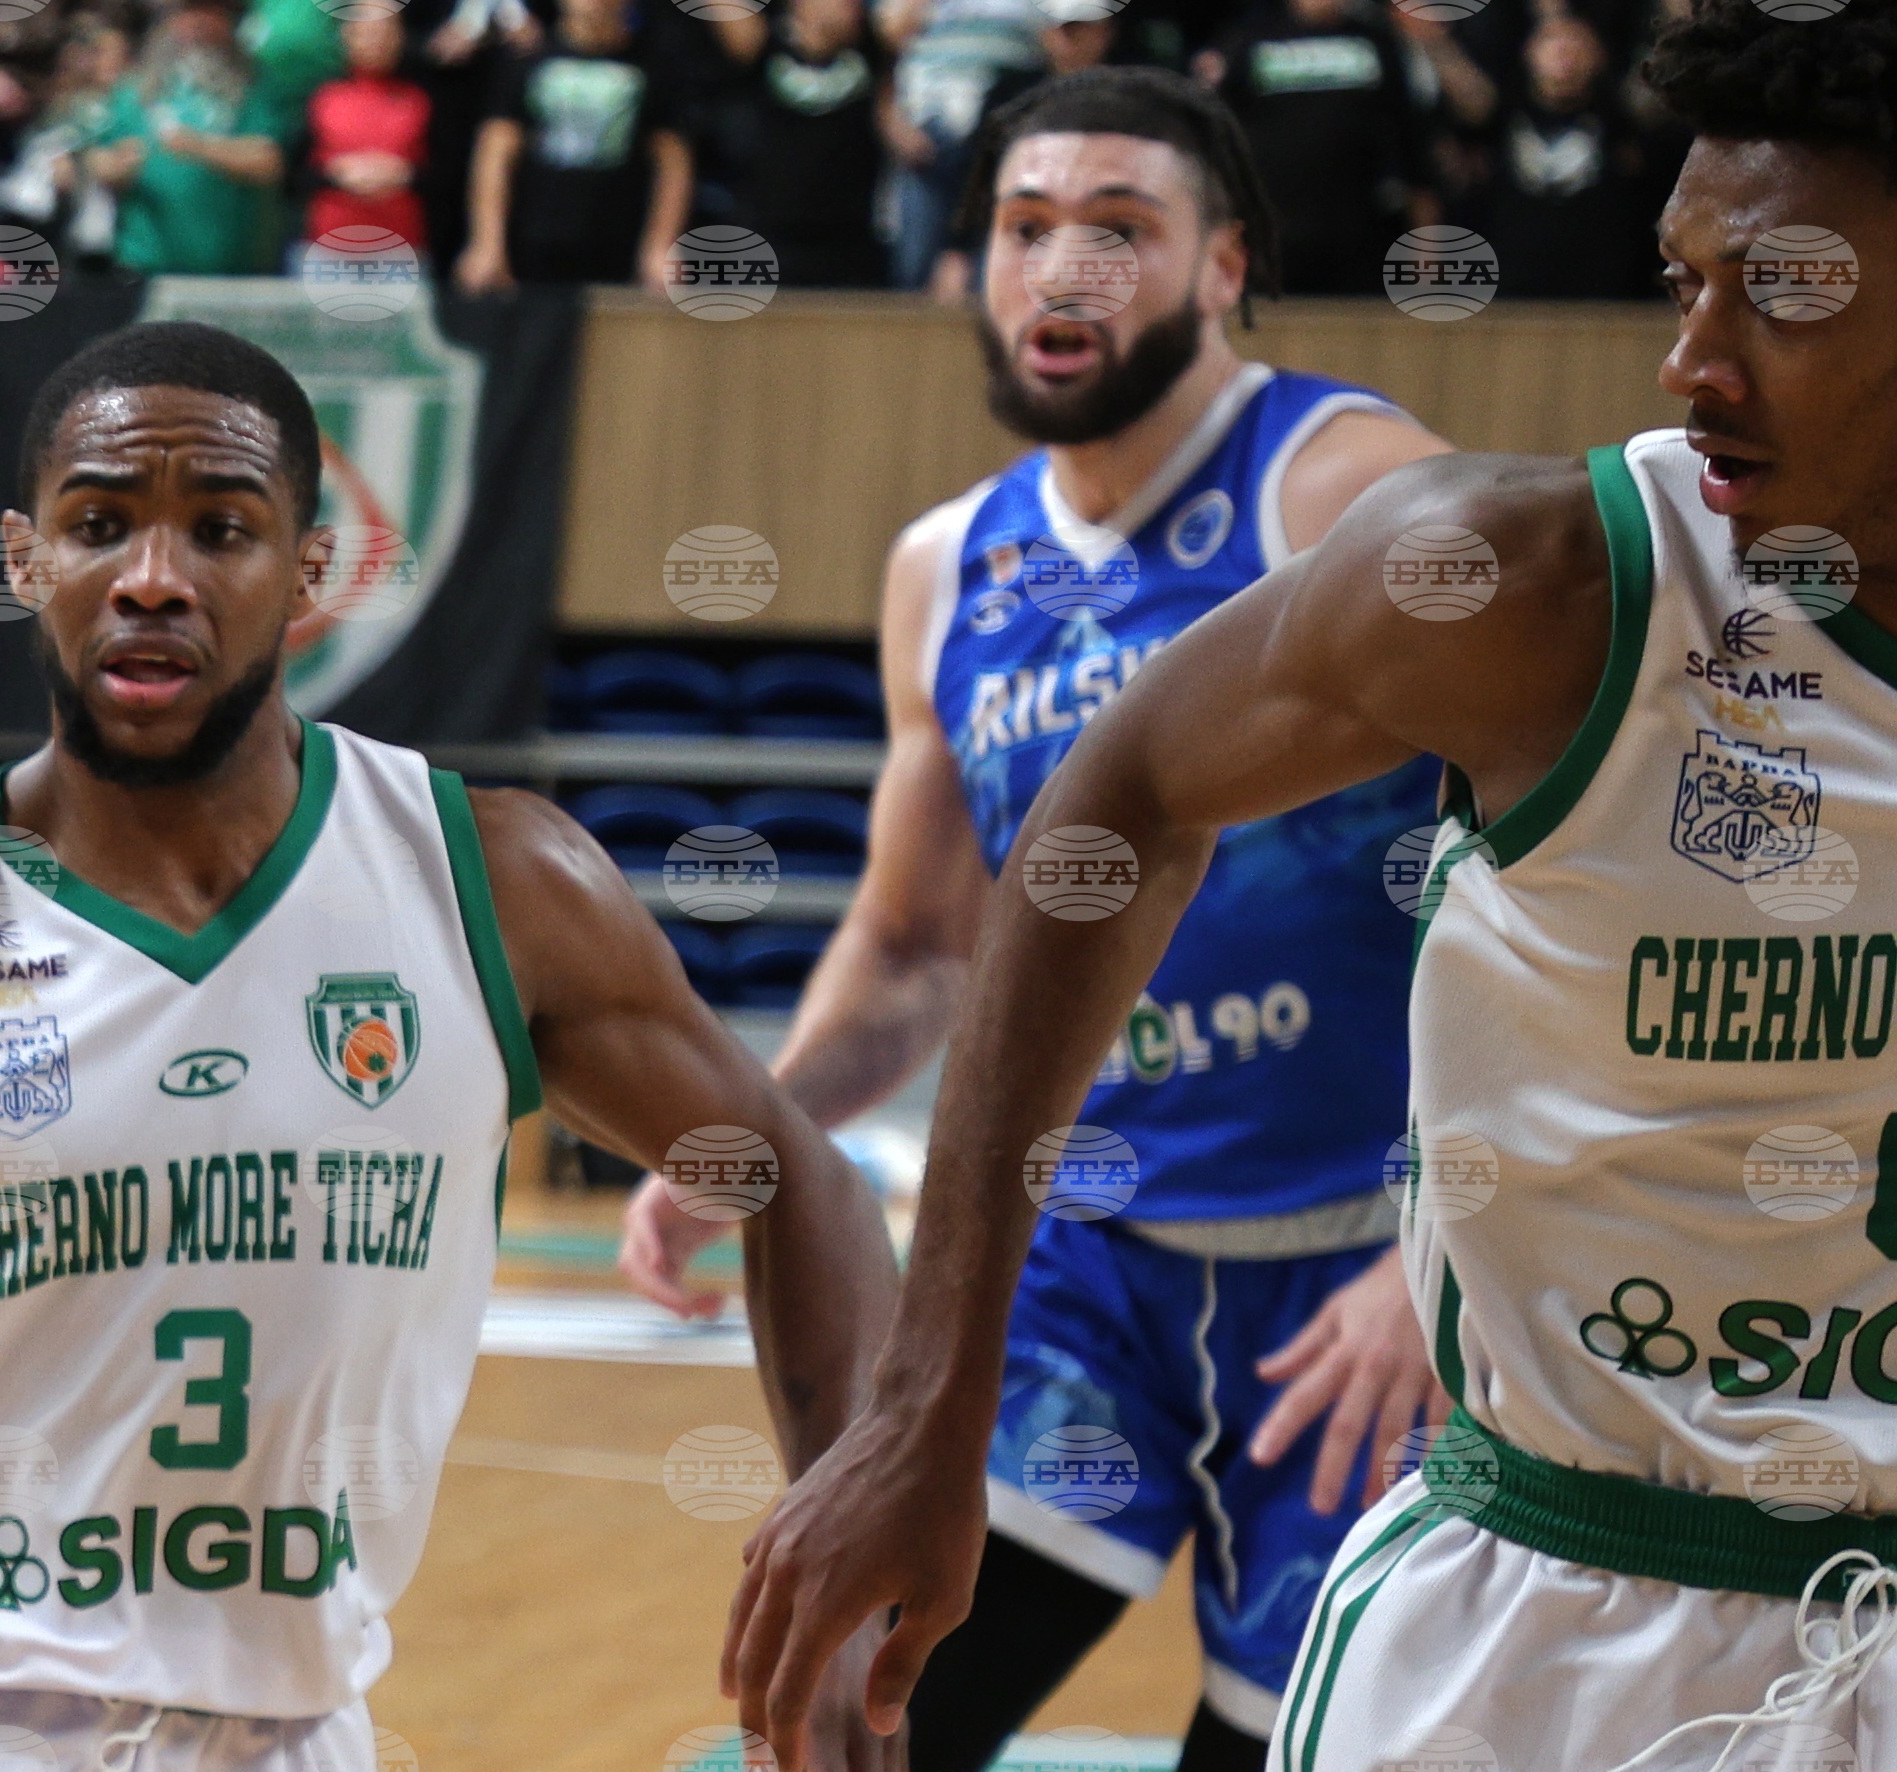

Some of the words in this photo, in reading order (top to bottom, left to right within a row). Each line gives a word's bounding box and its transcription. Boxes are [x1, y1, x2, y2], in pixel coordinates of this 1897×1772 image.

[1211, 980, 1311, 1065] 90
[1626, 933, 1897, 1063] CHERNO
[167, 1150, 298, 1265] MORE
[317, 1150, 444, 1271] TICHA
[149, 1307, 252, 1471] 3
